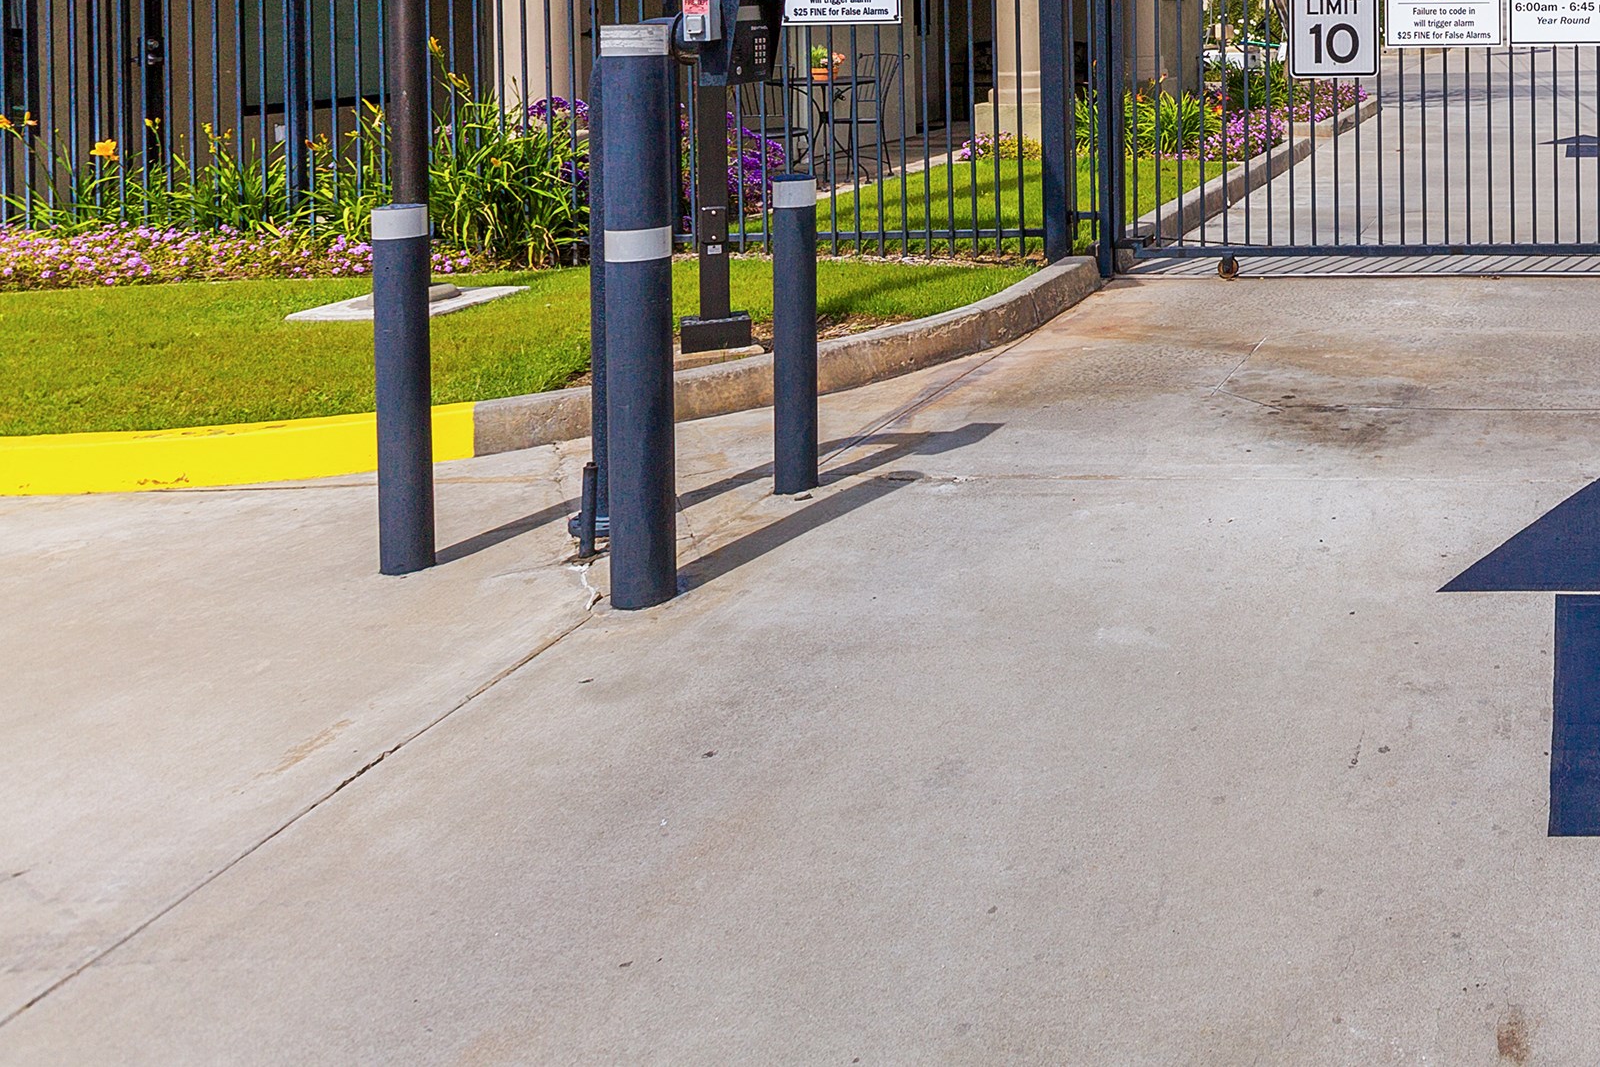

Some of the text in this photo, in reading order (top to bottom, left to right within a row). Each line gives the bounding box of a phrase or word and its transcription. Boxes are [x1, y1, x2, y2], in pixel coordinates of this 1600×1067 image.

[1413, 7, 1437, 15] Failure
[1515, 2, 1558, 11] 6:00am
[1569, 2, 1595, 11] 6:45
[793, 8, 808, 16] $25
[810, 8, 826, 16] FINE
[841, 7, 861, 15] False
[863, 7, 889, 15] Alarms
[1428, 20, 1452, 28] trigger
[1537, 16, 1590, 24] Year Round
[1397, 31, 1412, 40] $25
[1433, 31, 1442, 39] for
[1445, 31, 1464, 39] False
[1309, 23, 1359, 64] 10
